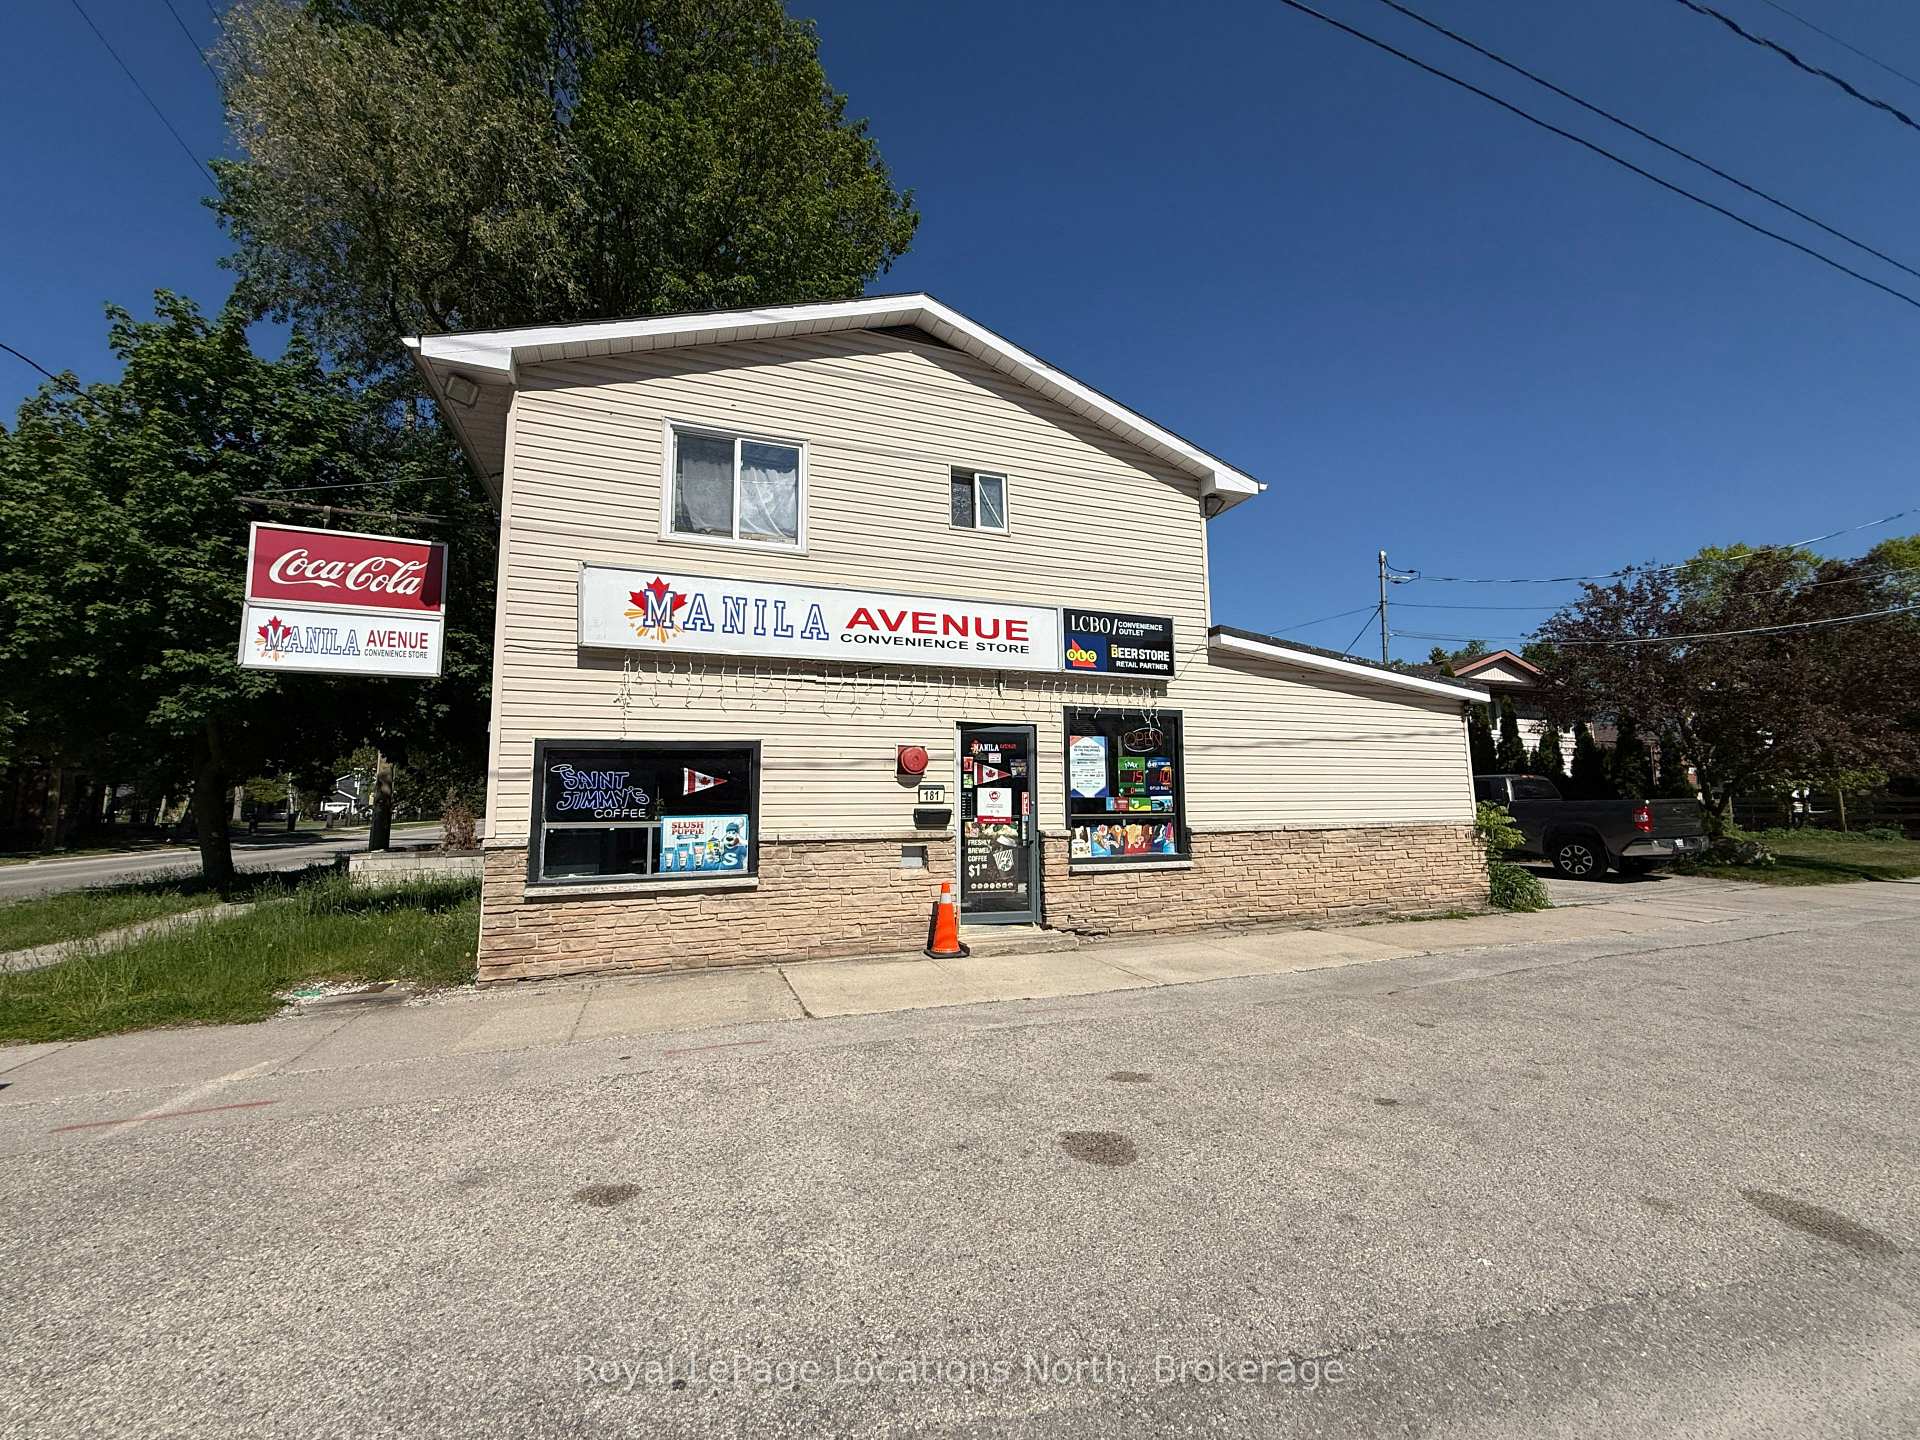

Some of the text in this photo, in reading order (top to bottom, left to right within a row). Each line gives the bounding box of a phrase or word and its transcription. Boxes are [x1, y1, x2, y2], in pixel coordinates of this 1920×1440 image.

[269, 548, 428, 595] Coca-Cola
[643, 588, 1030, 642] MANILA AVENUE
[1071, 614, 1163, 634] LCBO CONVENIENCE
[264, 624, 429, 656] MANILA AVENUE
[840, 633, 1030, 654] CONVENIENCE STORE
[364, 648, 428, 659] CONVENIENCE STORE
[1067, 649, 1097, 662] OLG
[1111, 647, 1170, 661] BEER STORE
[1140, 661, 1168, 670] PARTNER
[1124, 731, 1163, 746] OPEN
[560, 767, 630, 790] SAINT
[556, 786, 650, 810] JIMMY'S
[924, 790, 940, 801] 181
[594, 808, 646, 818] COFFEE
